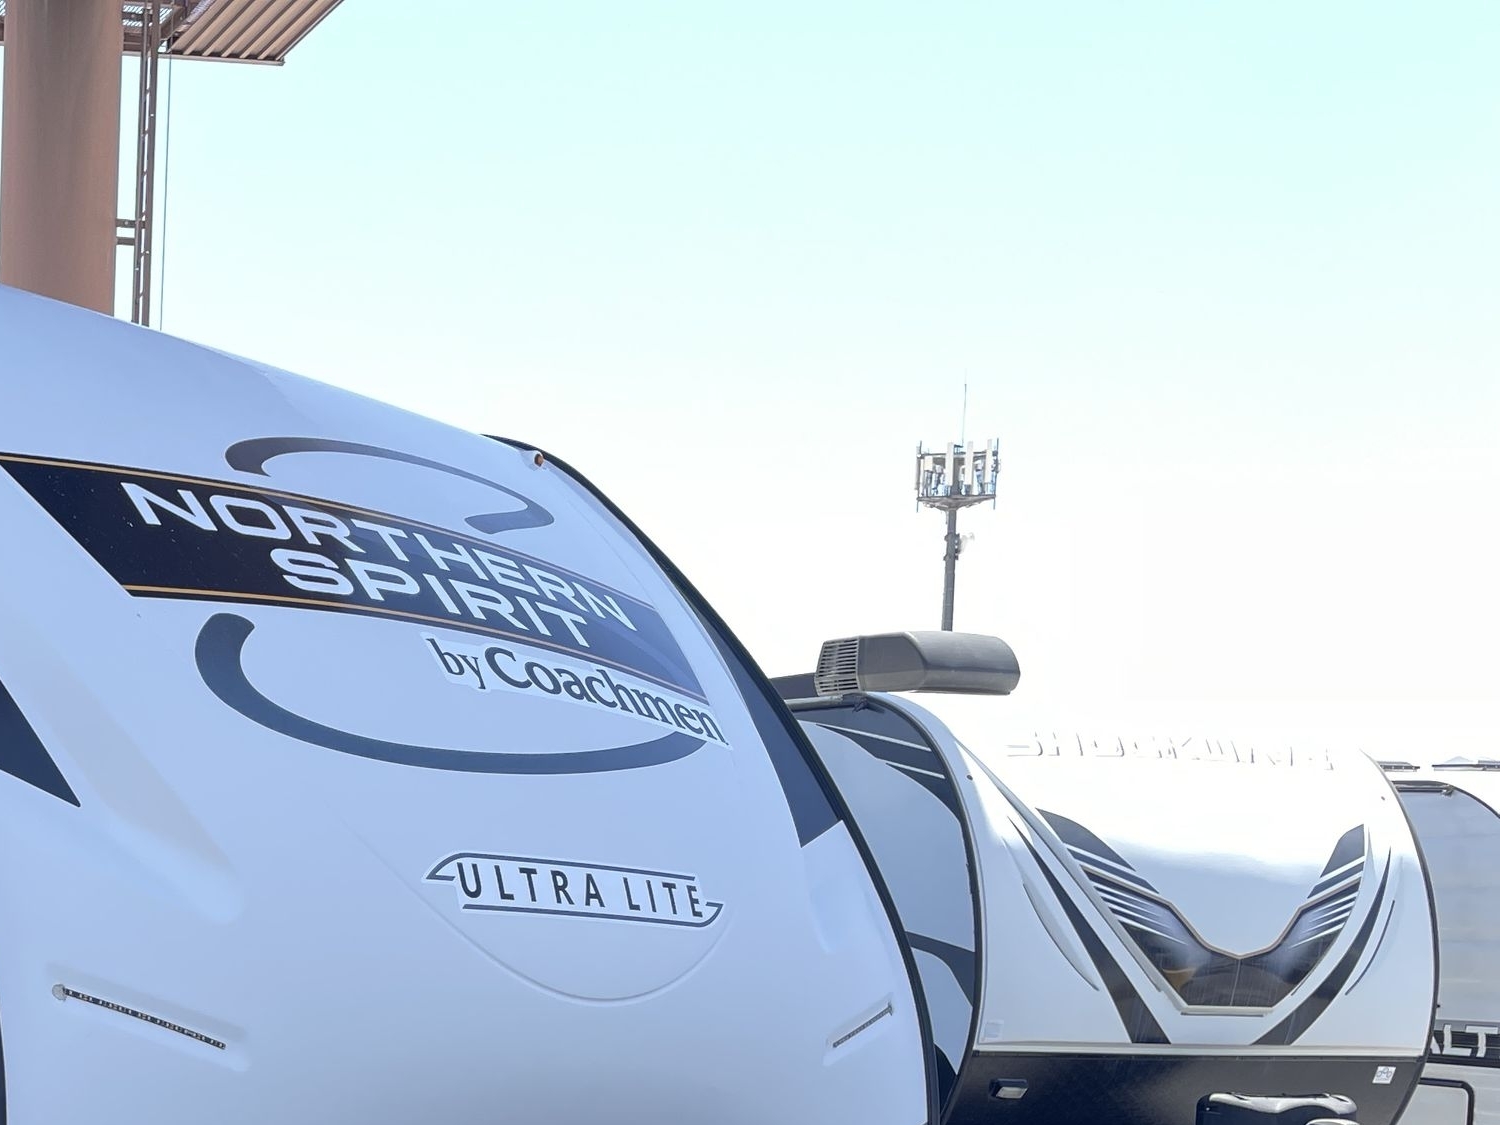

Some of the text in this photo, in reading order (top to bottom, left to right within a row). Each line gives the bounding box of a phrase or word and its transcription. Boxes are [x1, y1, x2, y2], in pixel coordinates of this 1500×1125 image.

[120, 482, 638, 632] NORTHERN
[269, 548, 590, 648] SPIRIT
[426, 638, 729, 746] by Coachmen
[456, 861, 704, 918] ULTRA LITE
